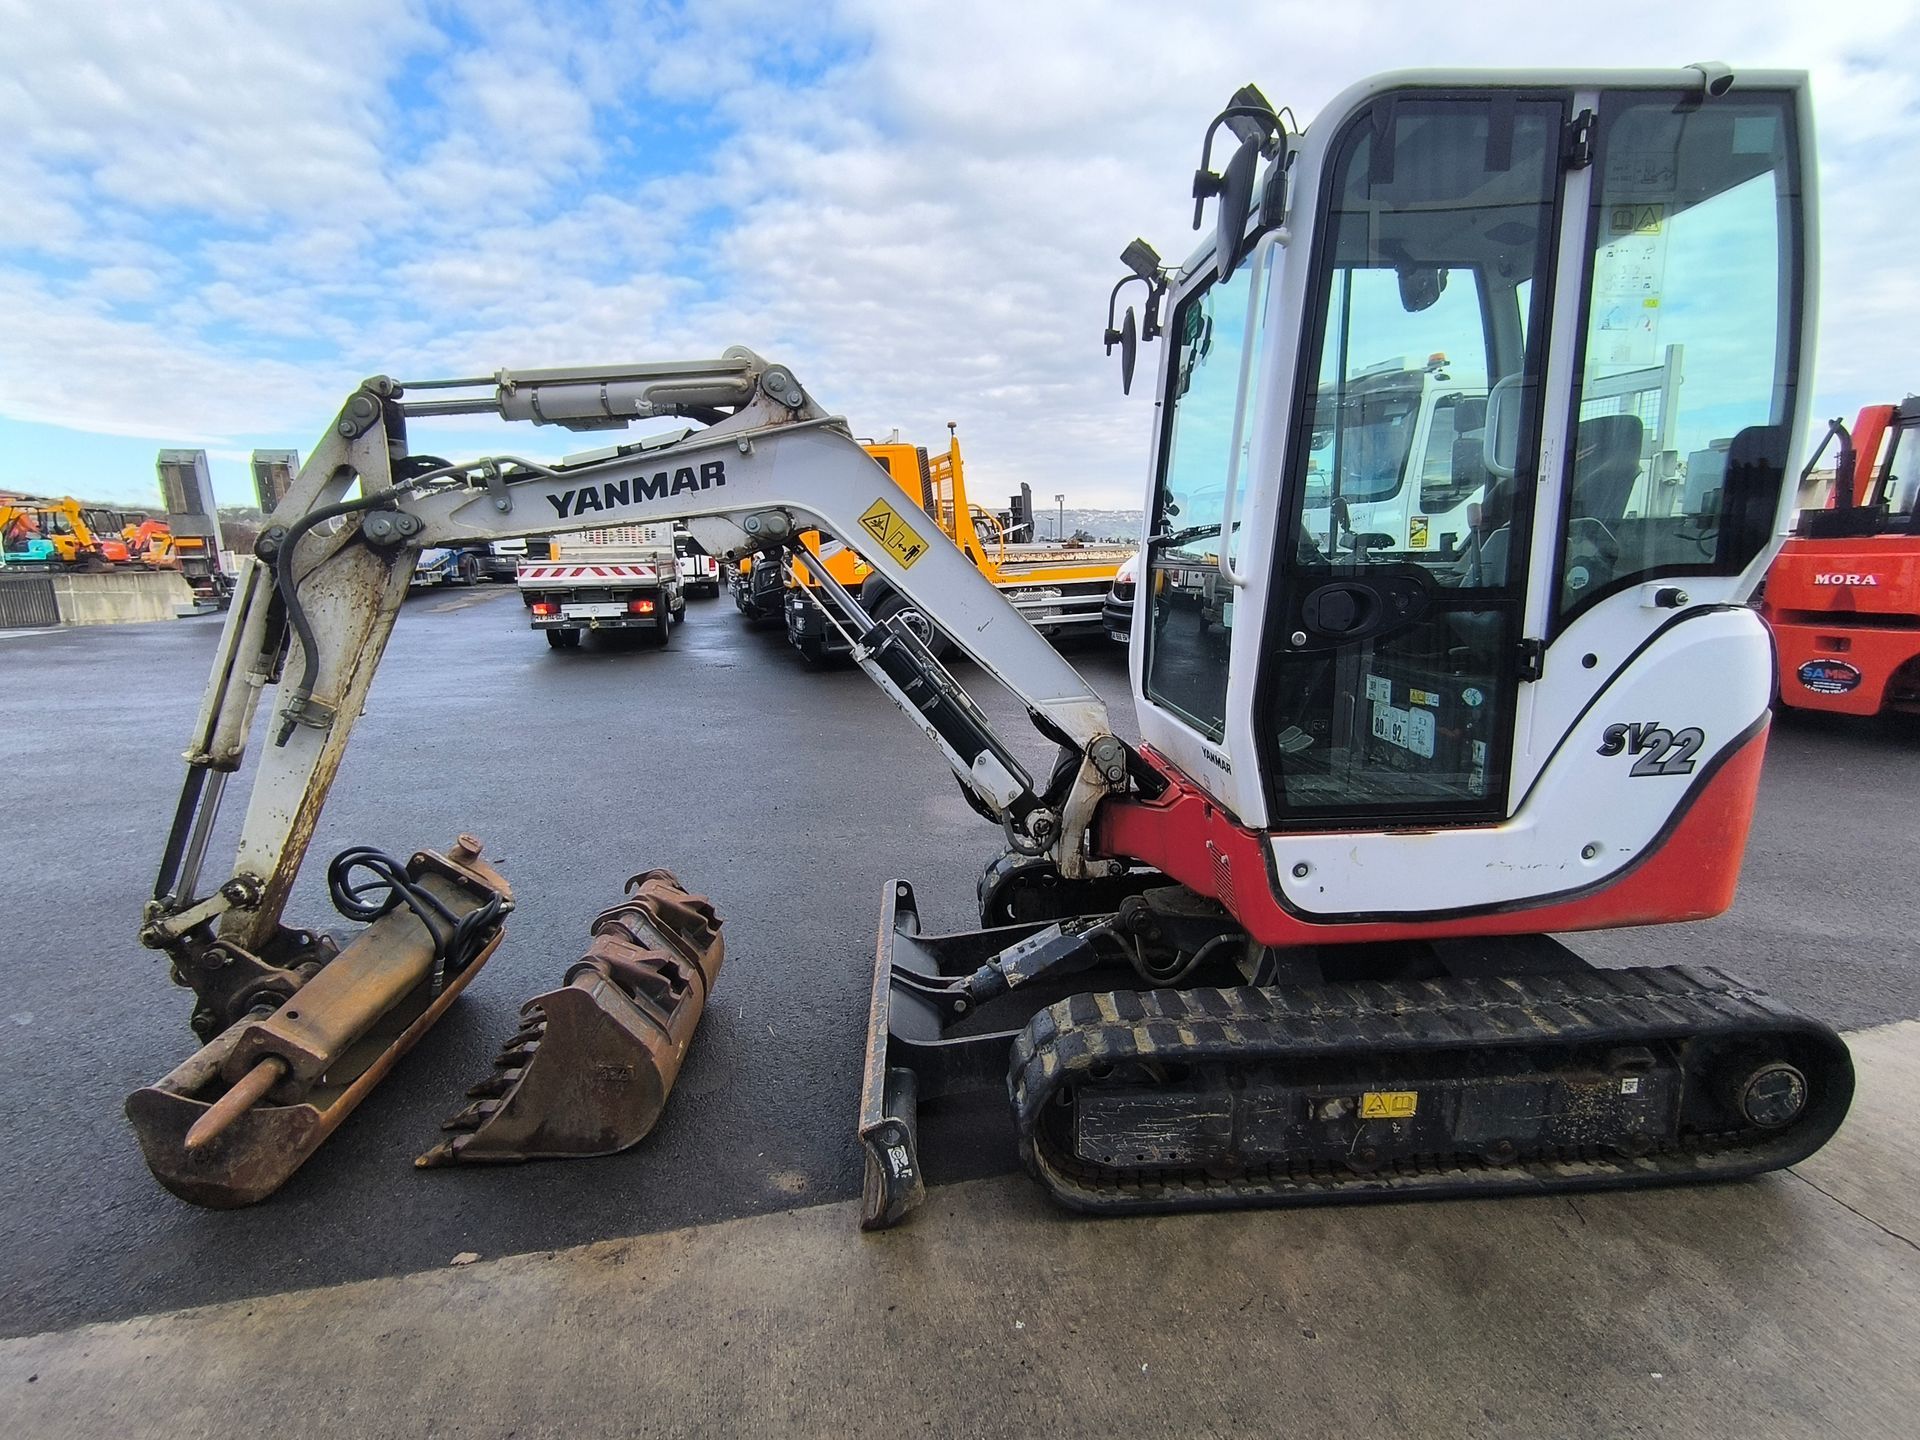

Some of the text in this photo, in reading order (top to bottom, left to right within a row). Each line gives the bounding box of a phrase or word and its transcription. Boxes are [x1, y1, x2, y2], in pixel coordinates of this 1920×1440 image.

[546, 461, 726, 519] YANMAR
[1814, 574, 1877, 585] MORA
[1375, 717, 1384, 735] 80
[1392, 723, 1402, 742] 92
[1201, 746, 1232, 775] YANMAR
